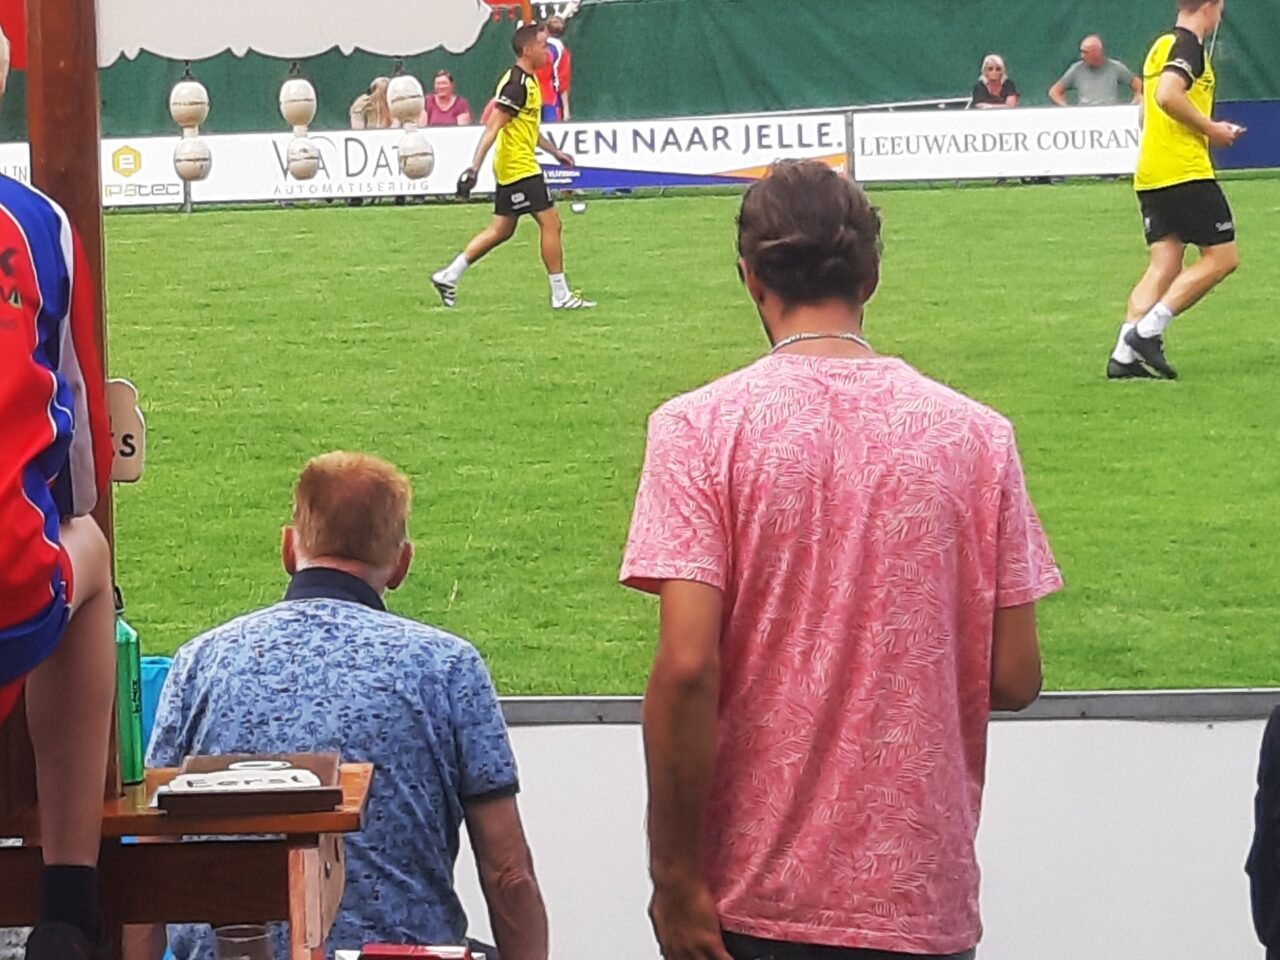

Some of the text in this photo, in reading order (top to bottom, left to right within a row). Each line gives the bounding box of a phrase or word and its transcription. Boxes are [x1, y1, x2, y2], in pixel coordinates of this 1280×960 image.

[535, 128, 618, 157] VEN
[632, 125, 732, 154] NAAR
[859, 127, 1140, 157] LEEUWARDER COURAN
[273, 180, 430, 196] AUTOMATISERING
